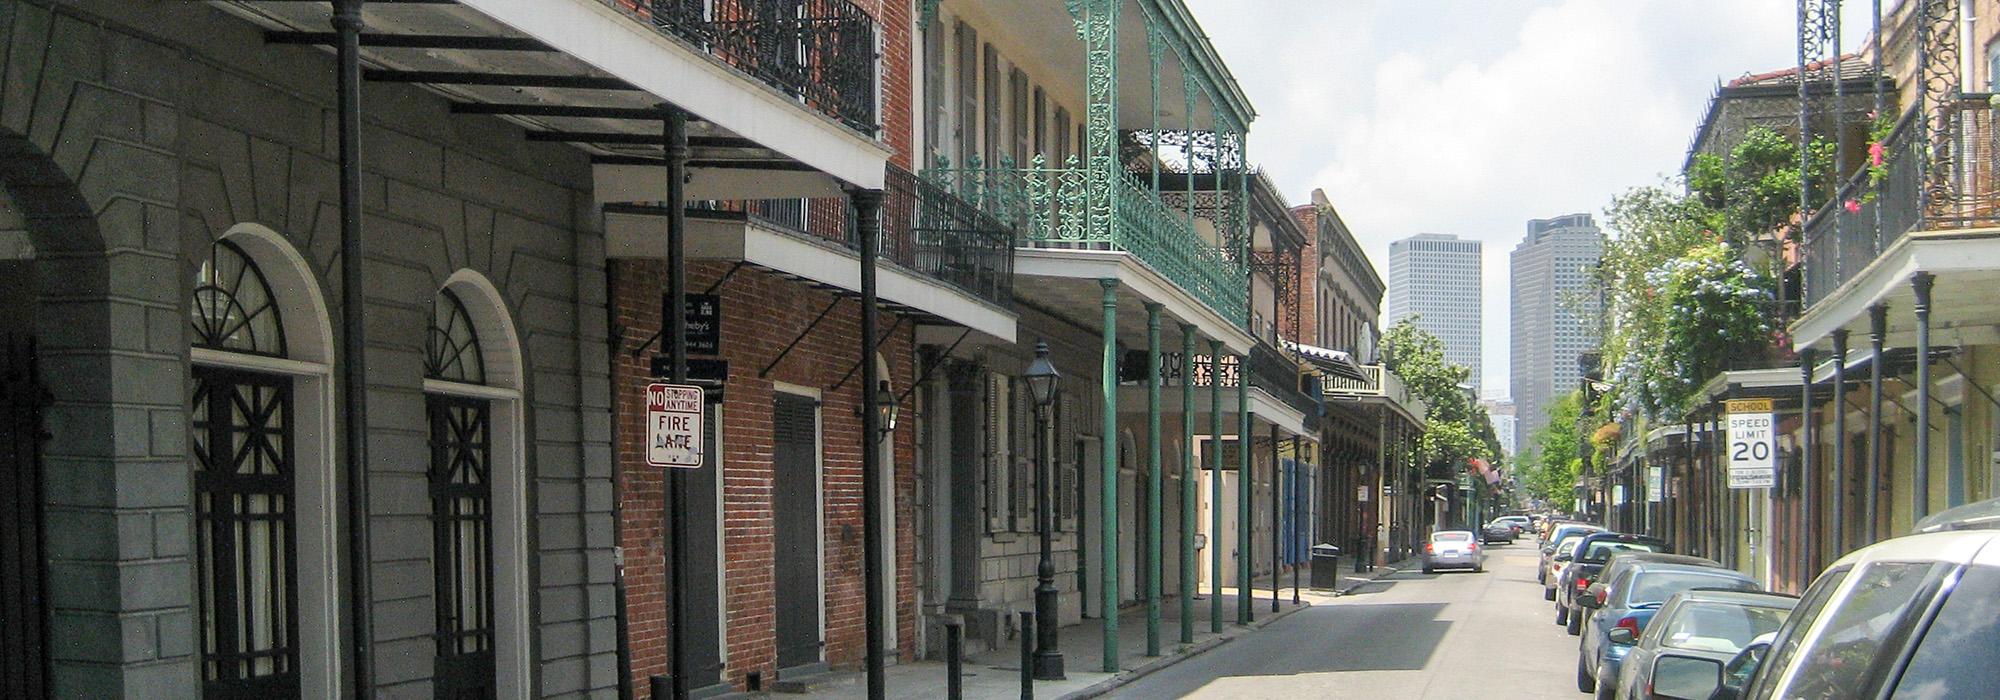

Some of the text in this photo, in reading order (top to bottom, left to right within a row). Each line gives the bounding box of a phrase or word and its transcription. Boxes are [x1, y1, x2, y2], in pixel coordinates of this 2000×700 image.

[685, 321, 709, 332] heby's
[649, 391, 664, 406] NO
[666, 389, 698, 400] STOPPING
[666, 400, 697, 411] ANYTIME
[1731, 402, 1769, 411] SCHOOL
[659, 416, 690, 431] FIRE
[1731, 419, 1769, 428] SPEED
[1736, 430, 1766, 439] LIMIT
[1733, 441, 1769, 461] 20
